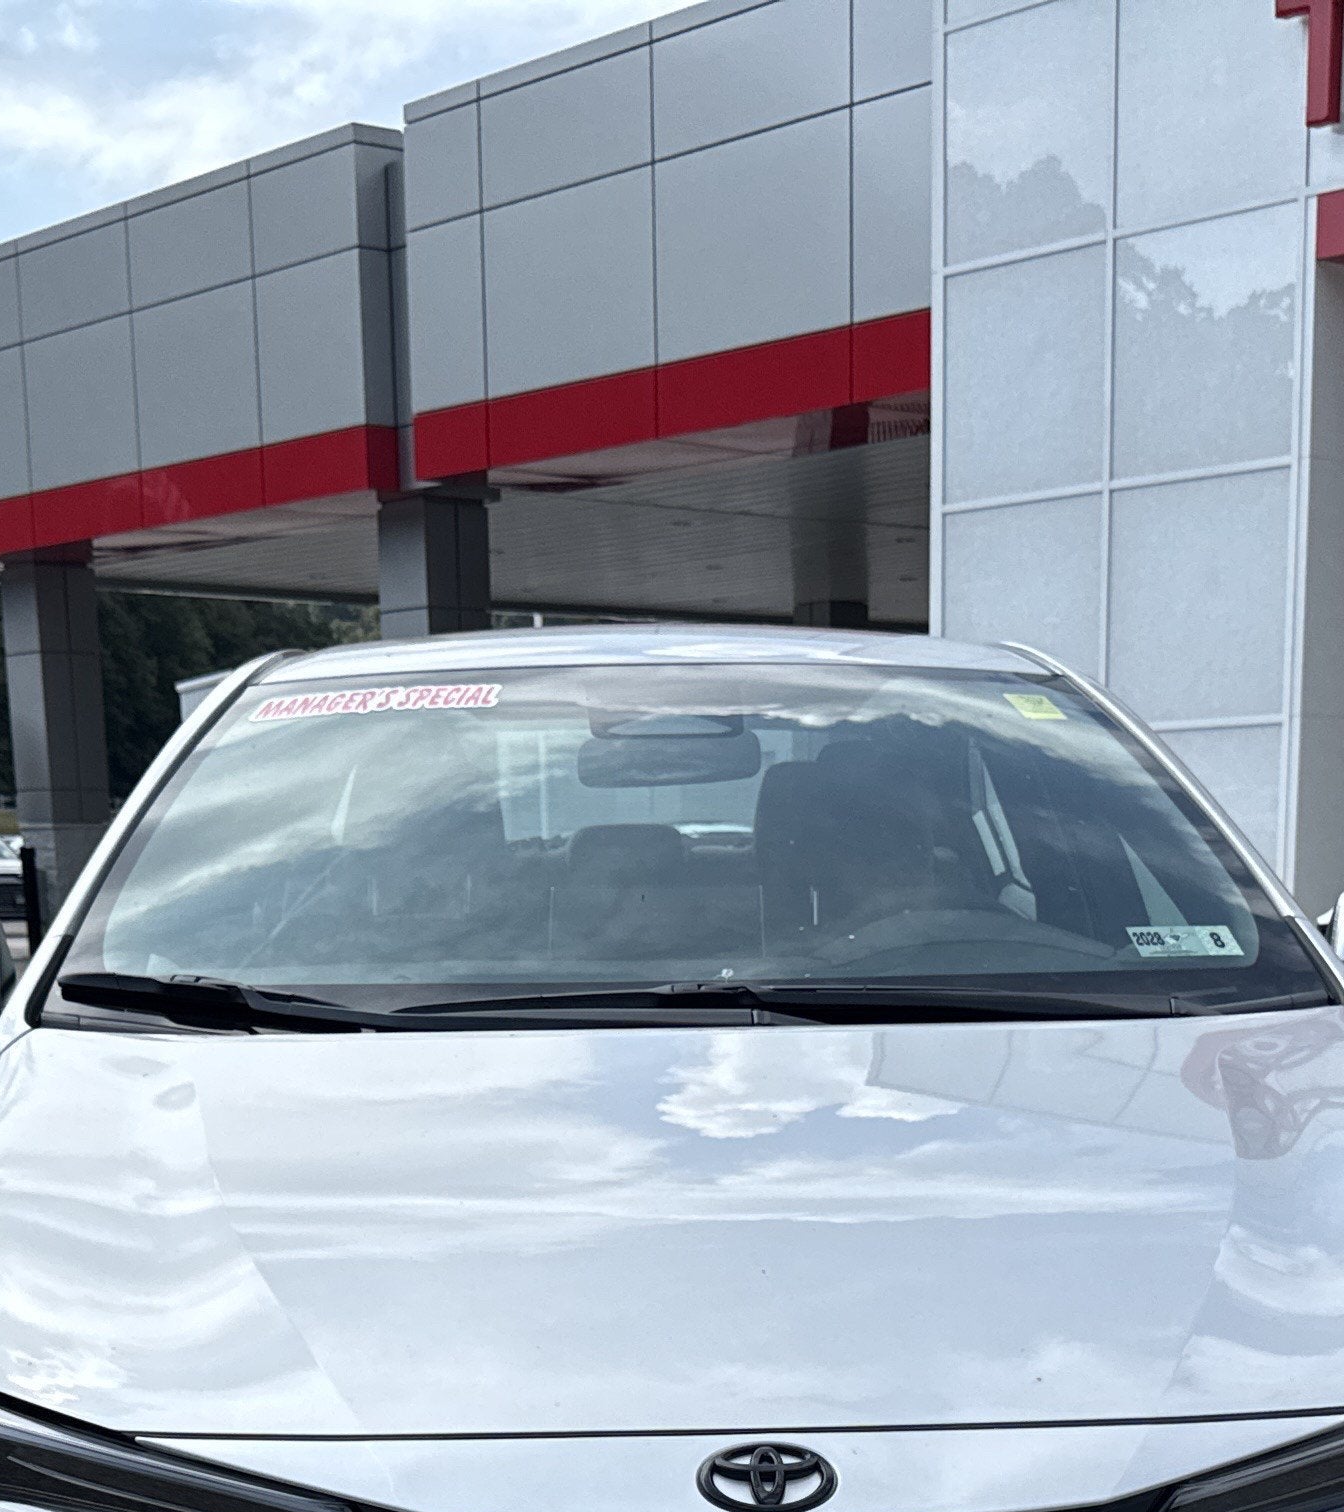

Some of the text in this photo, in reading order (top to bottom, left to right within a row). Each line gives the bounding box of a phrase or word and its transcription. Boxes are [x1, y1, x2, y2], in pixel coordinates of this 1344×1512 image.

[255, 686, 496, 719] MANAGER'S SPECIAL
[1209, 931, 1226, 948] 8
